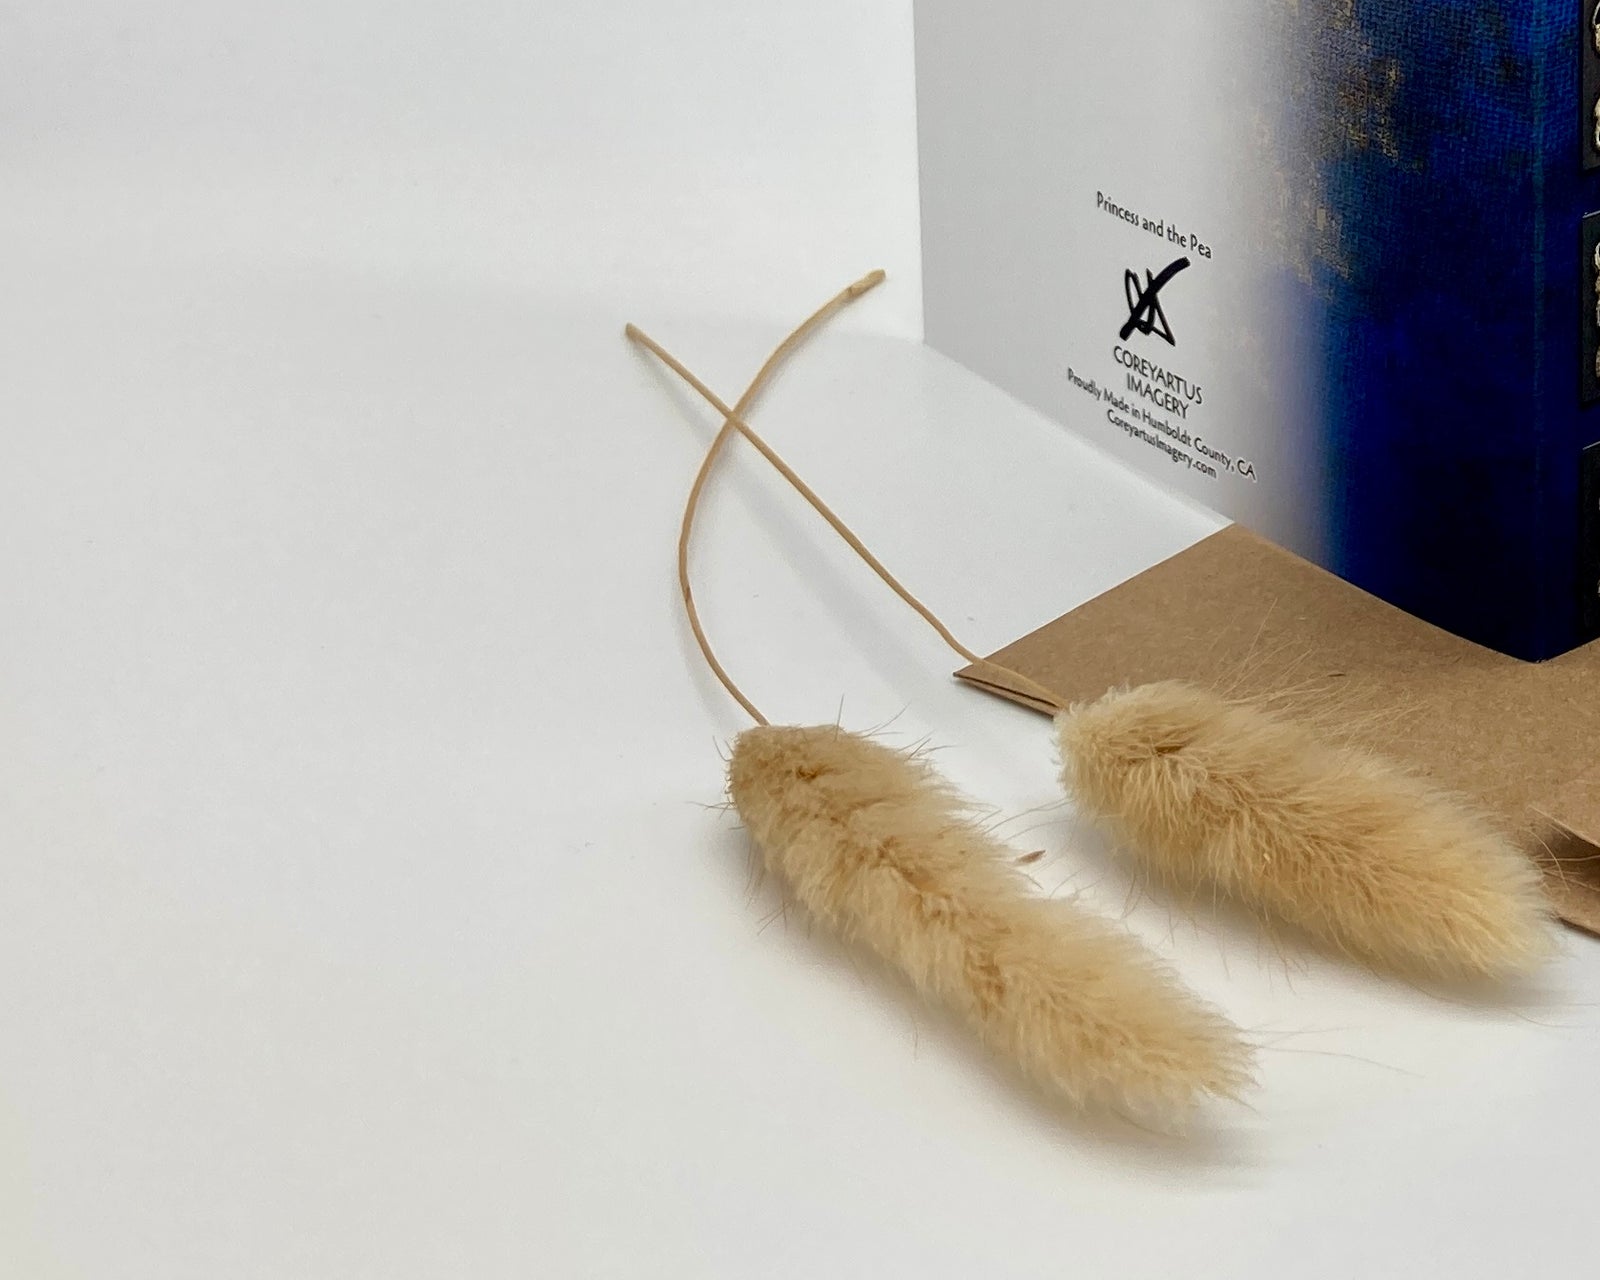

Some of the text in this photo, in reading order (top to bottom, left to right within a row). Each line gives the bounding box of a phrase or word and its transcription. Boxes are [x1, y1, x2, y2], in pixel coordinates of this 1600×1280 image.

[1097, 190, 1212, 259] Princess and the Pea
[1114, 345, 1202, 404] COREYARTUS
[1127, 372, 1189, 419] IMAGERY
[1068, 367, 1257, 481] Proudly Made in Humboldt County, CA
